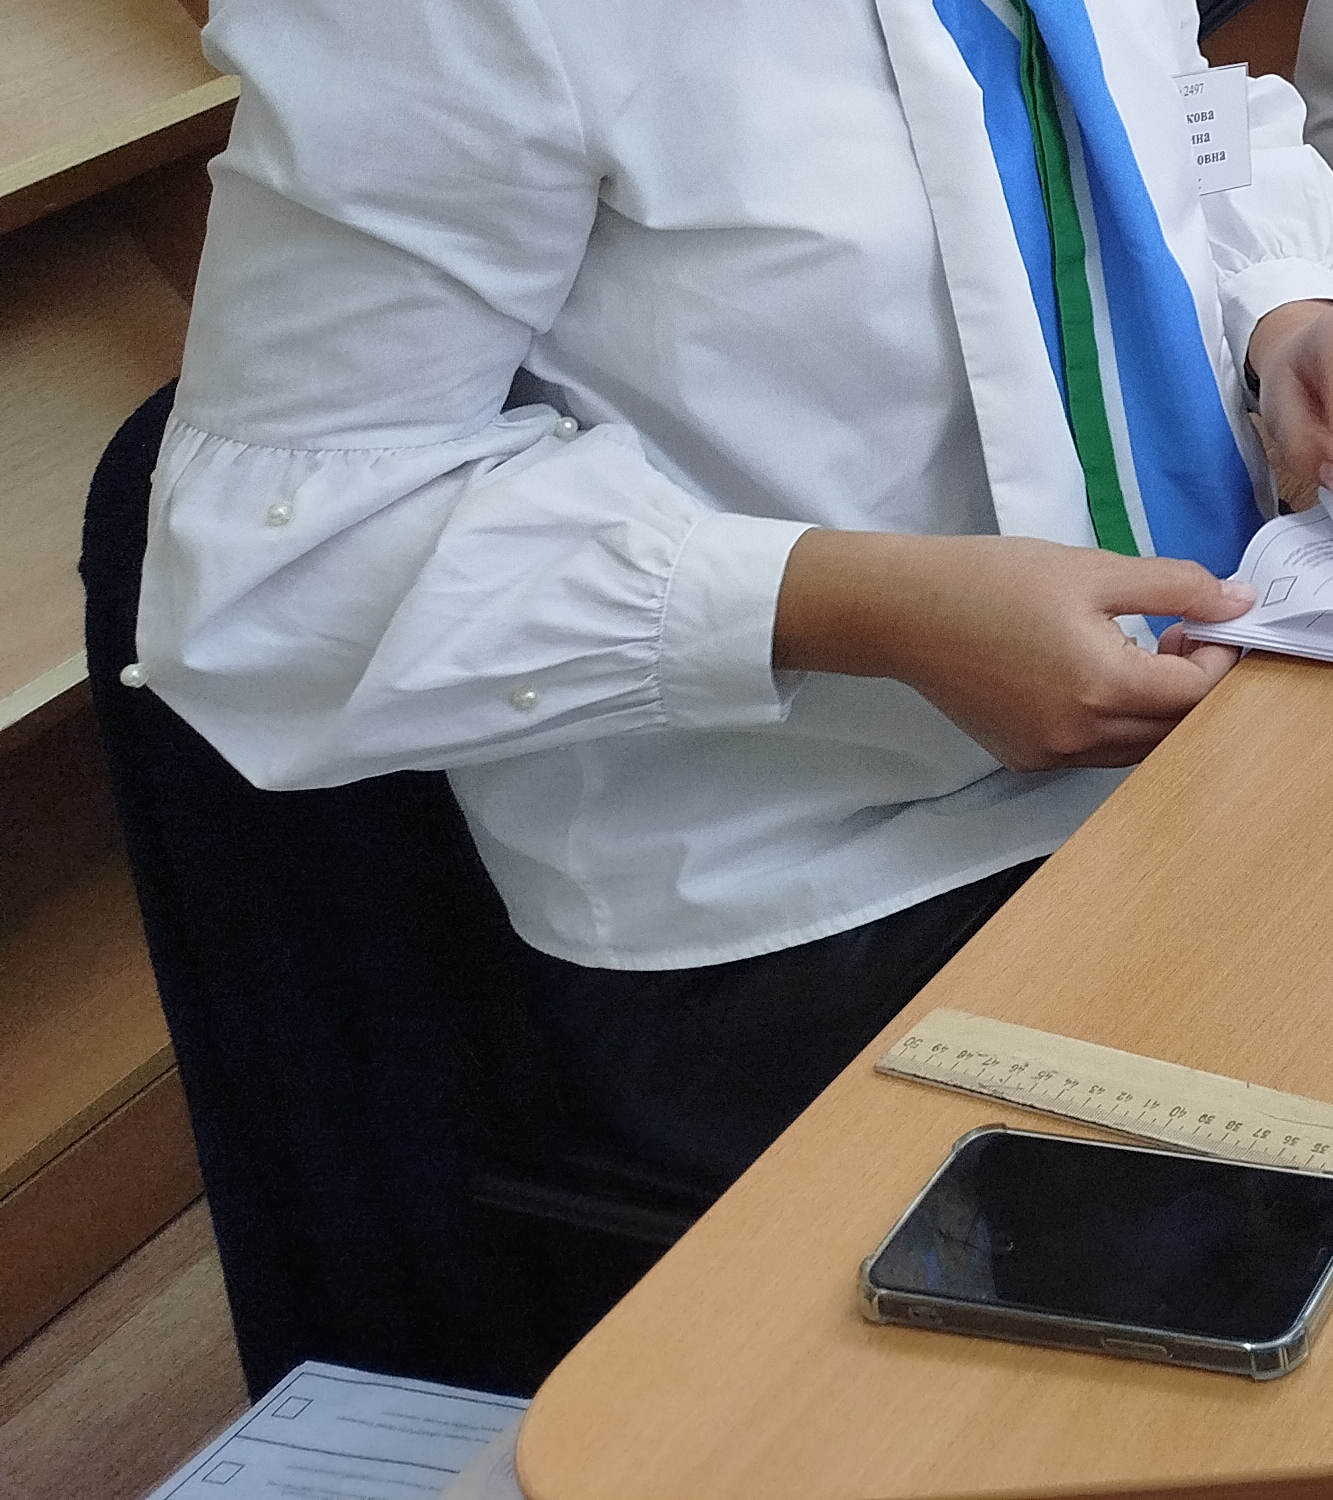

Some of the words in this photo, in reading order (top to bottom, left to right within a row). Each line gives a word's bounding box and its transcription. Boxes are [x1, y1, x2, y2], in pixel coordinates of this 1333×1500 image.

[1183, 82, 1204, 97] 2497
[1186, 110, 1215, 124] кова
[1197, 150, 1226, 165] овна
[903, 1036, 923, 1049] 50
[931, 1042, 949, 1053] 49
[956, 1049, 974, 1060] 48
[982, 1056, 1000, 1068] 47
[1088, 1084, 1106, 1096] 43
[1115, 1091, 1133, 1103] 42
[1142, 1098, 1160, 1109] 41
[1168, 1105, 1188, 1118] 40
[1197, 1112, 1216, 1125] 39
[1224, 1119, 1243, 1132] 38
[1251, 1127, 1271, 1139] 37
[1282, 1133, 1301, 1147] 36
[1311, 1141, 1330, 1154] 35
